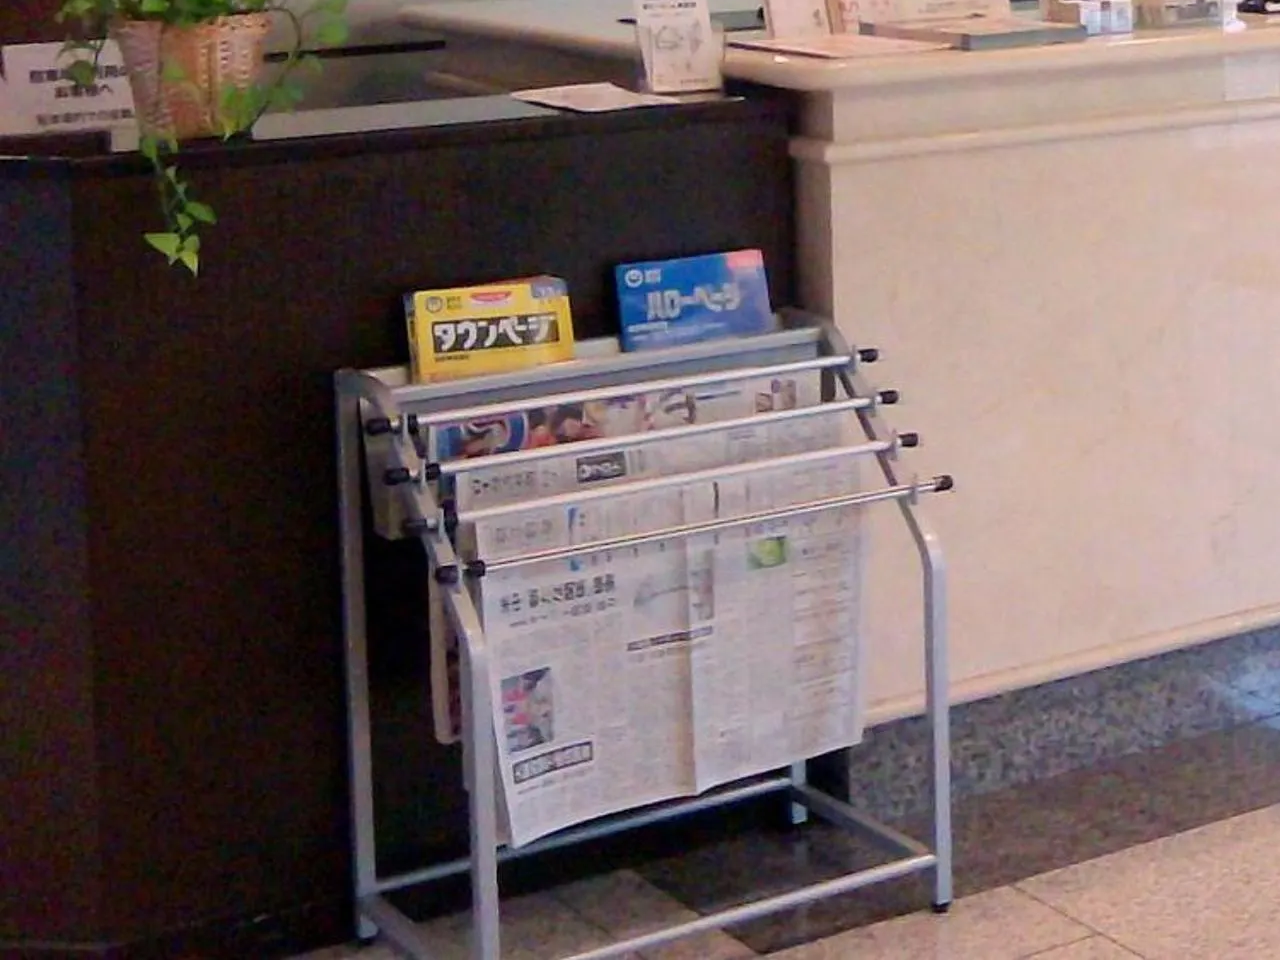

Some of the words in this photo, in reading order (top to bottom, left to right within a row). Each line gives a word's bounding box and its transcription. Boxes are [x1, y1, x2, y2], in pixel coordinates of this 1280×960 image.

[433, 315, 557, 352] タウンページ
